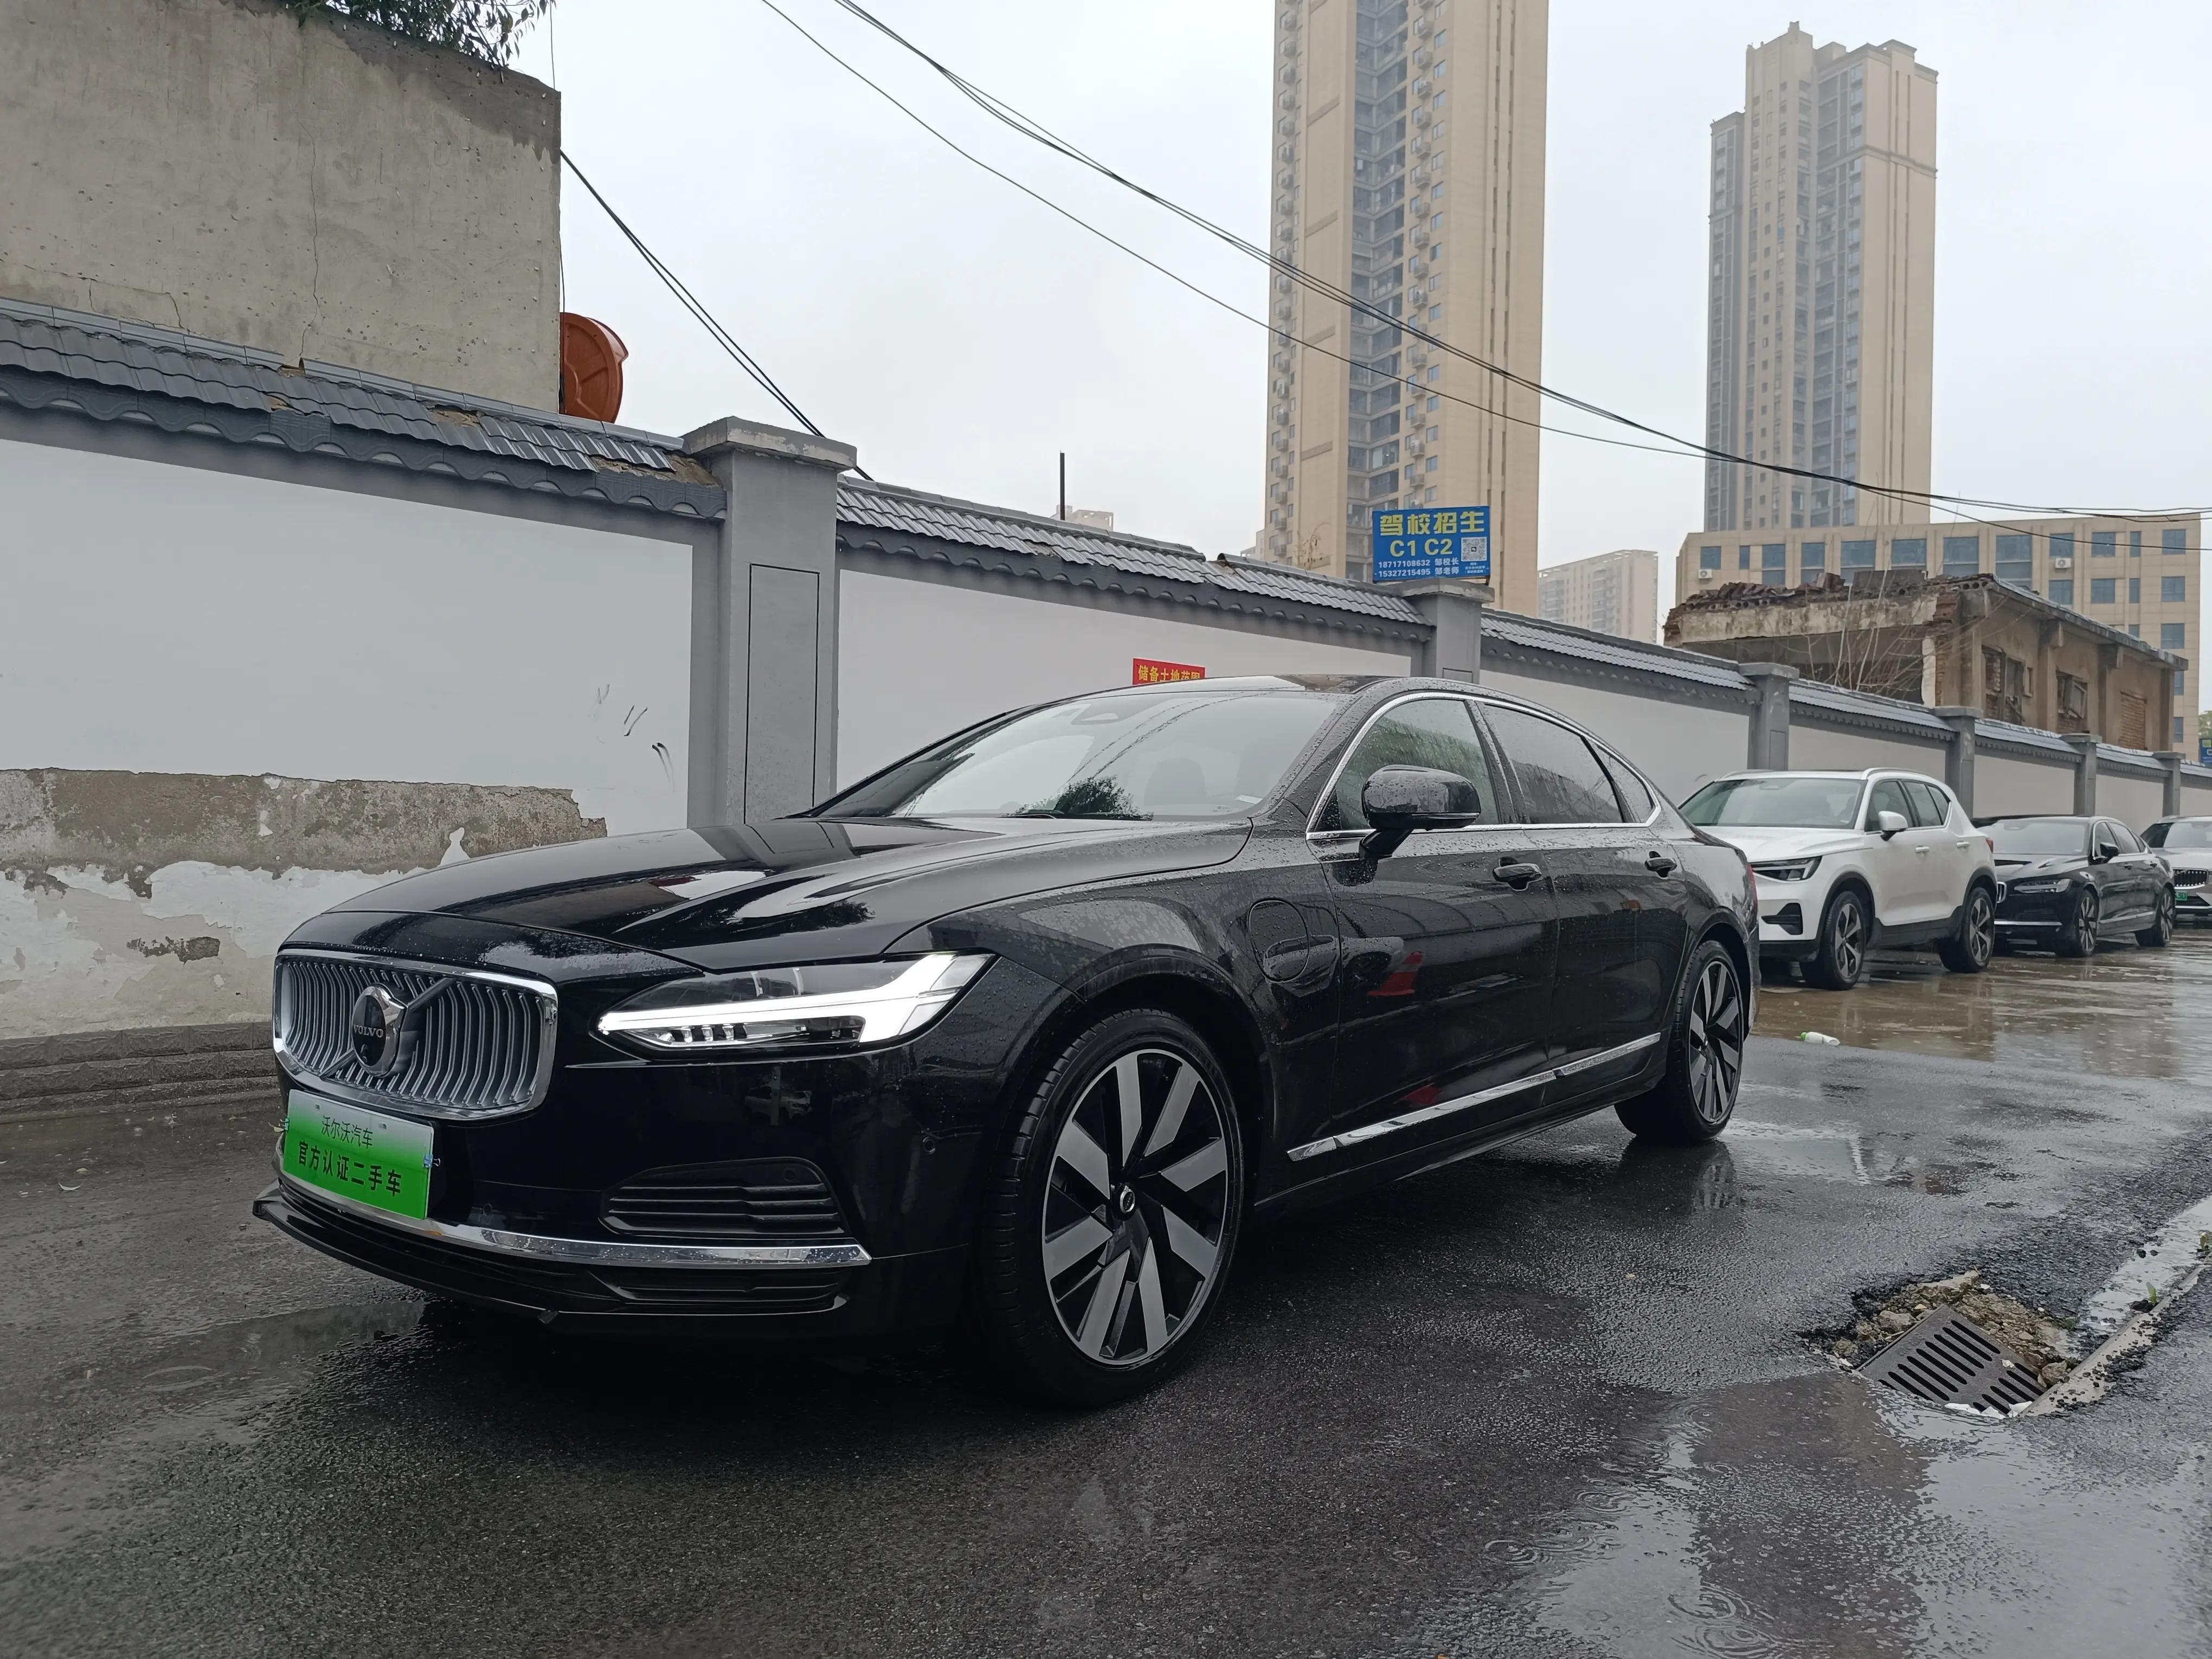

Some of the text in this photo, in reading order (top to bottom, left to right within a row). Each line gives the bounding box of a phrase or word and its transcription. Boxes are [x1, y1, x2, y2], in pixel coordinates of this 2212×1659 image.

[1380, 511, 1484, 536] 驾校招生
[1390, 538, 1452, 557] C1 C2
[1378, 560, 1430, 568] 18717108632
[1379, 569, 1431, 577] 15327215495
[353, 1024, 384, 1039] VOLVO
[321, 1115, 374, 1149] 沃尔沃汽车
[298, 1140, 402, 1197] 官方认证二手车
